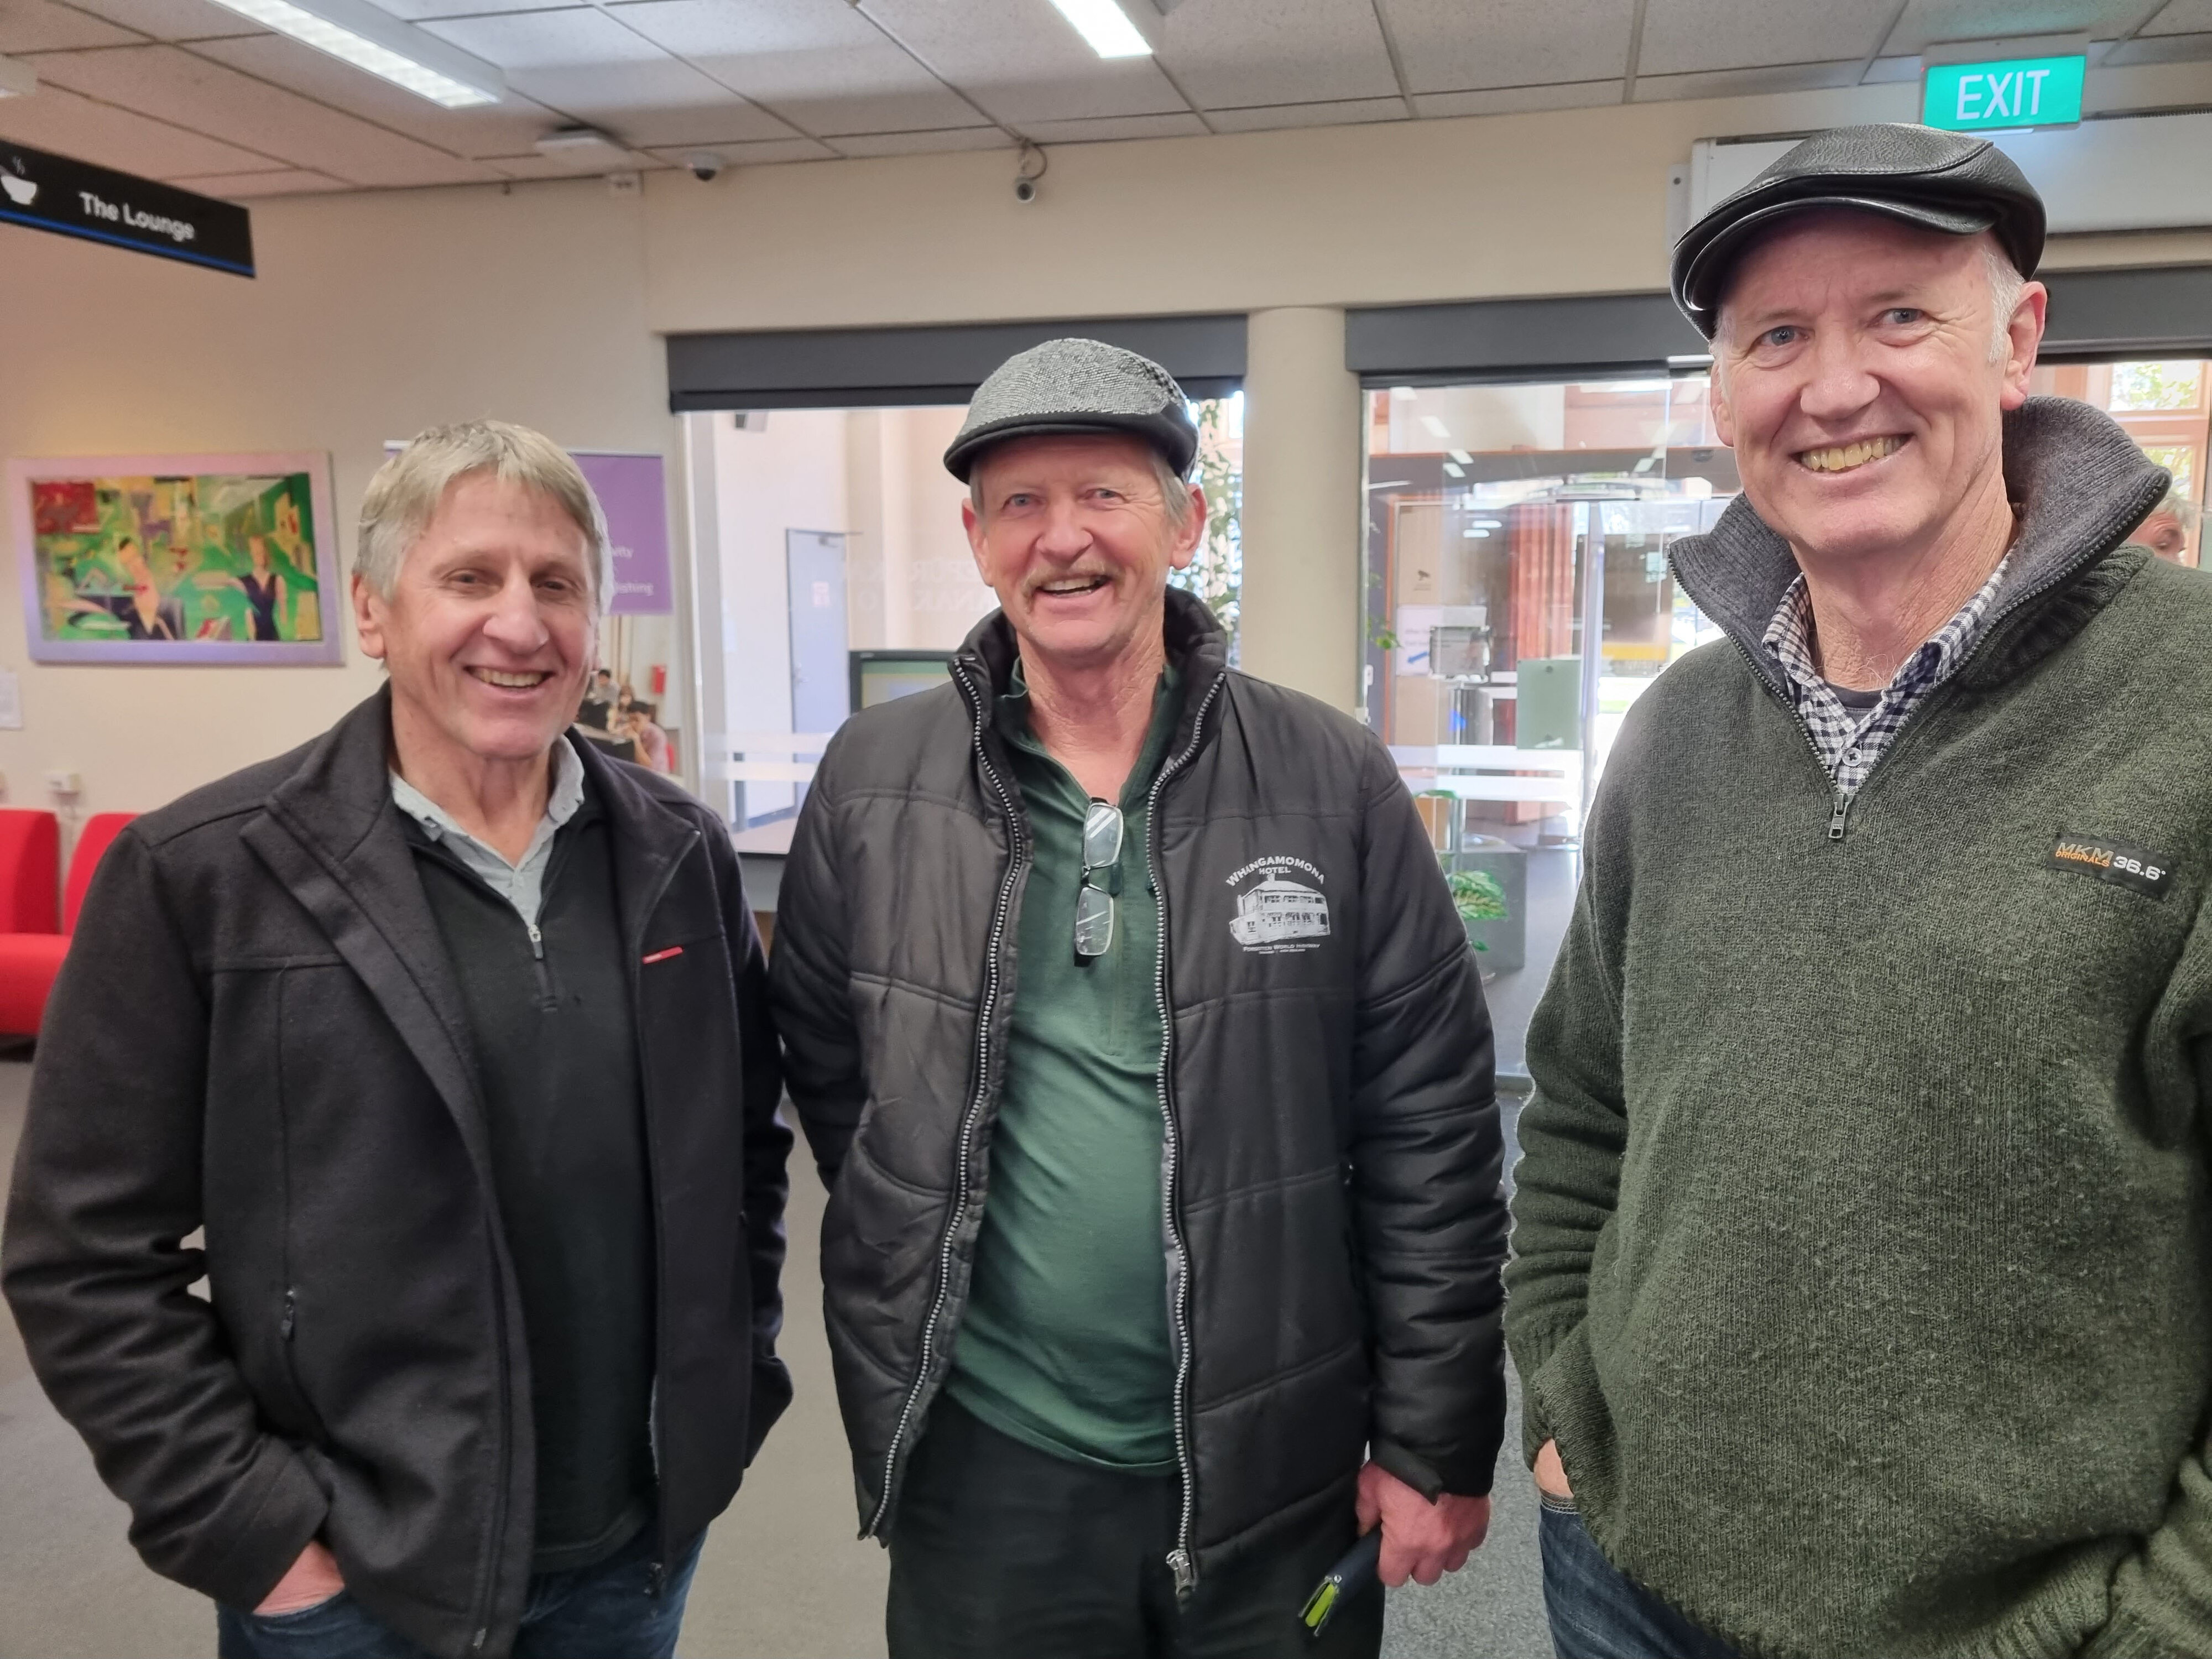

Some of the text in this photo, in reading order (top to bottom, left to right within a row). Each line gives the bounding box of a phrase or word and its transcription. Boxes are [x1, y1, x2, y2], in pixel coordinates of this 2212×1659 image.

[1956, 69, 2051, 121] EXIT
[79, 191, 196, 242] The Lounge
[2056, 850, 2110, 868] ORIGINALS
[2057, 842, 2115, 862] MKM
[1225, 855, 1325, 887] WHANGAMOMONA
[1259, 866, 1292, 875] HOTEL
